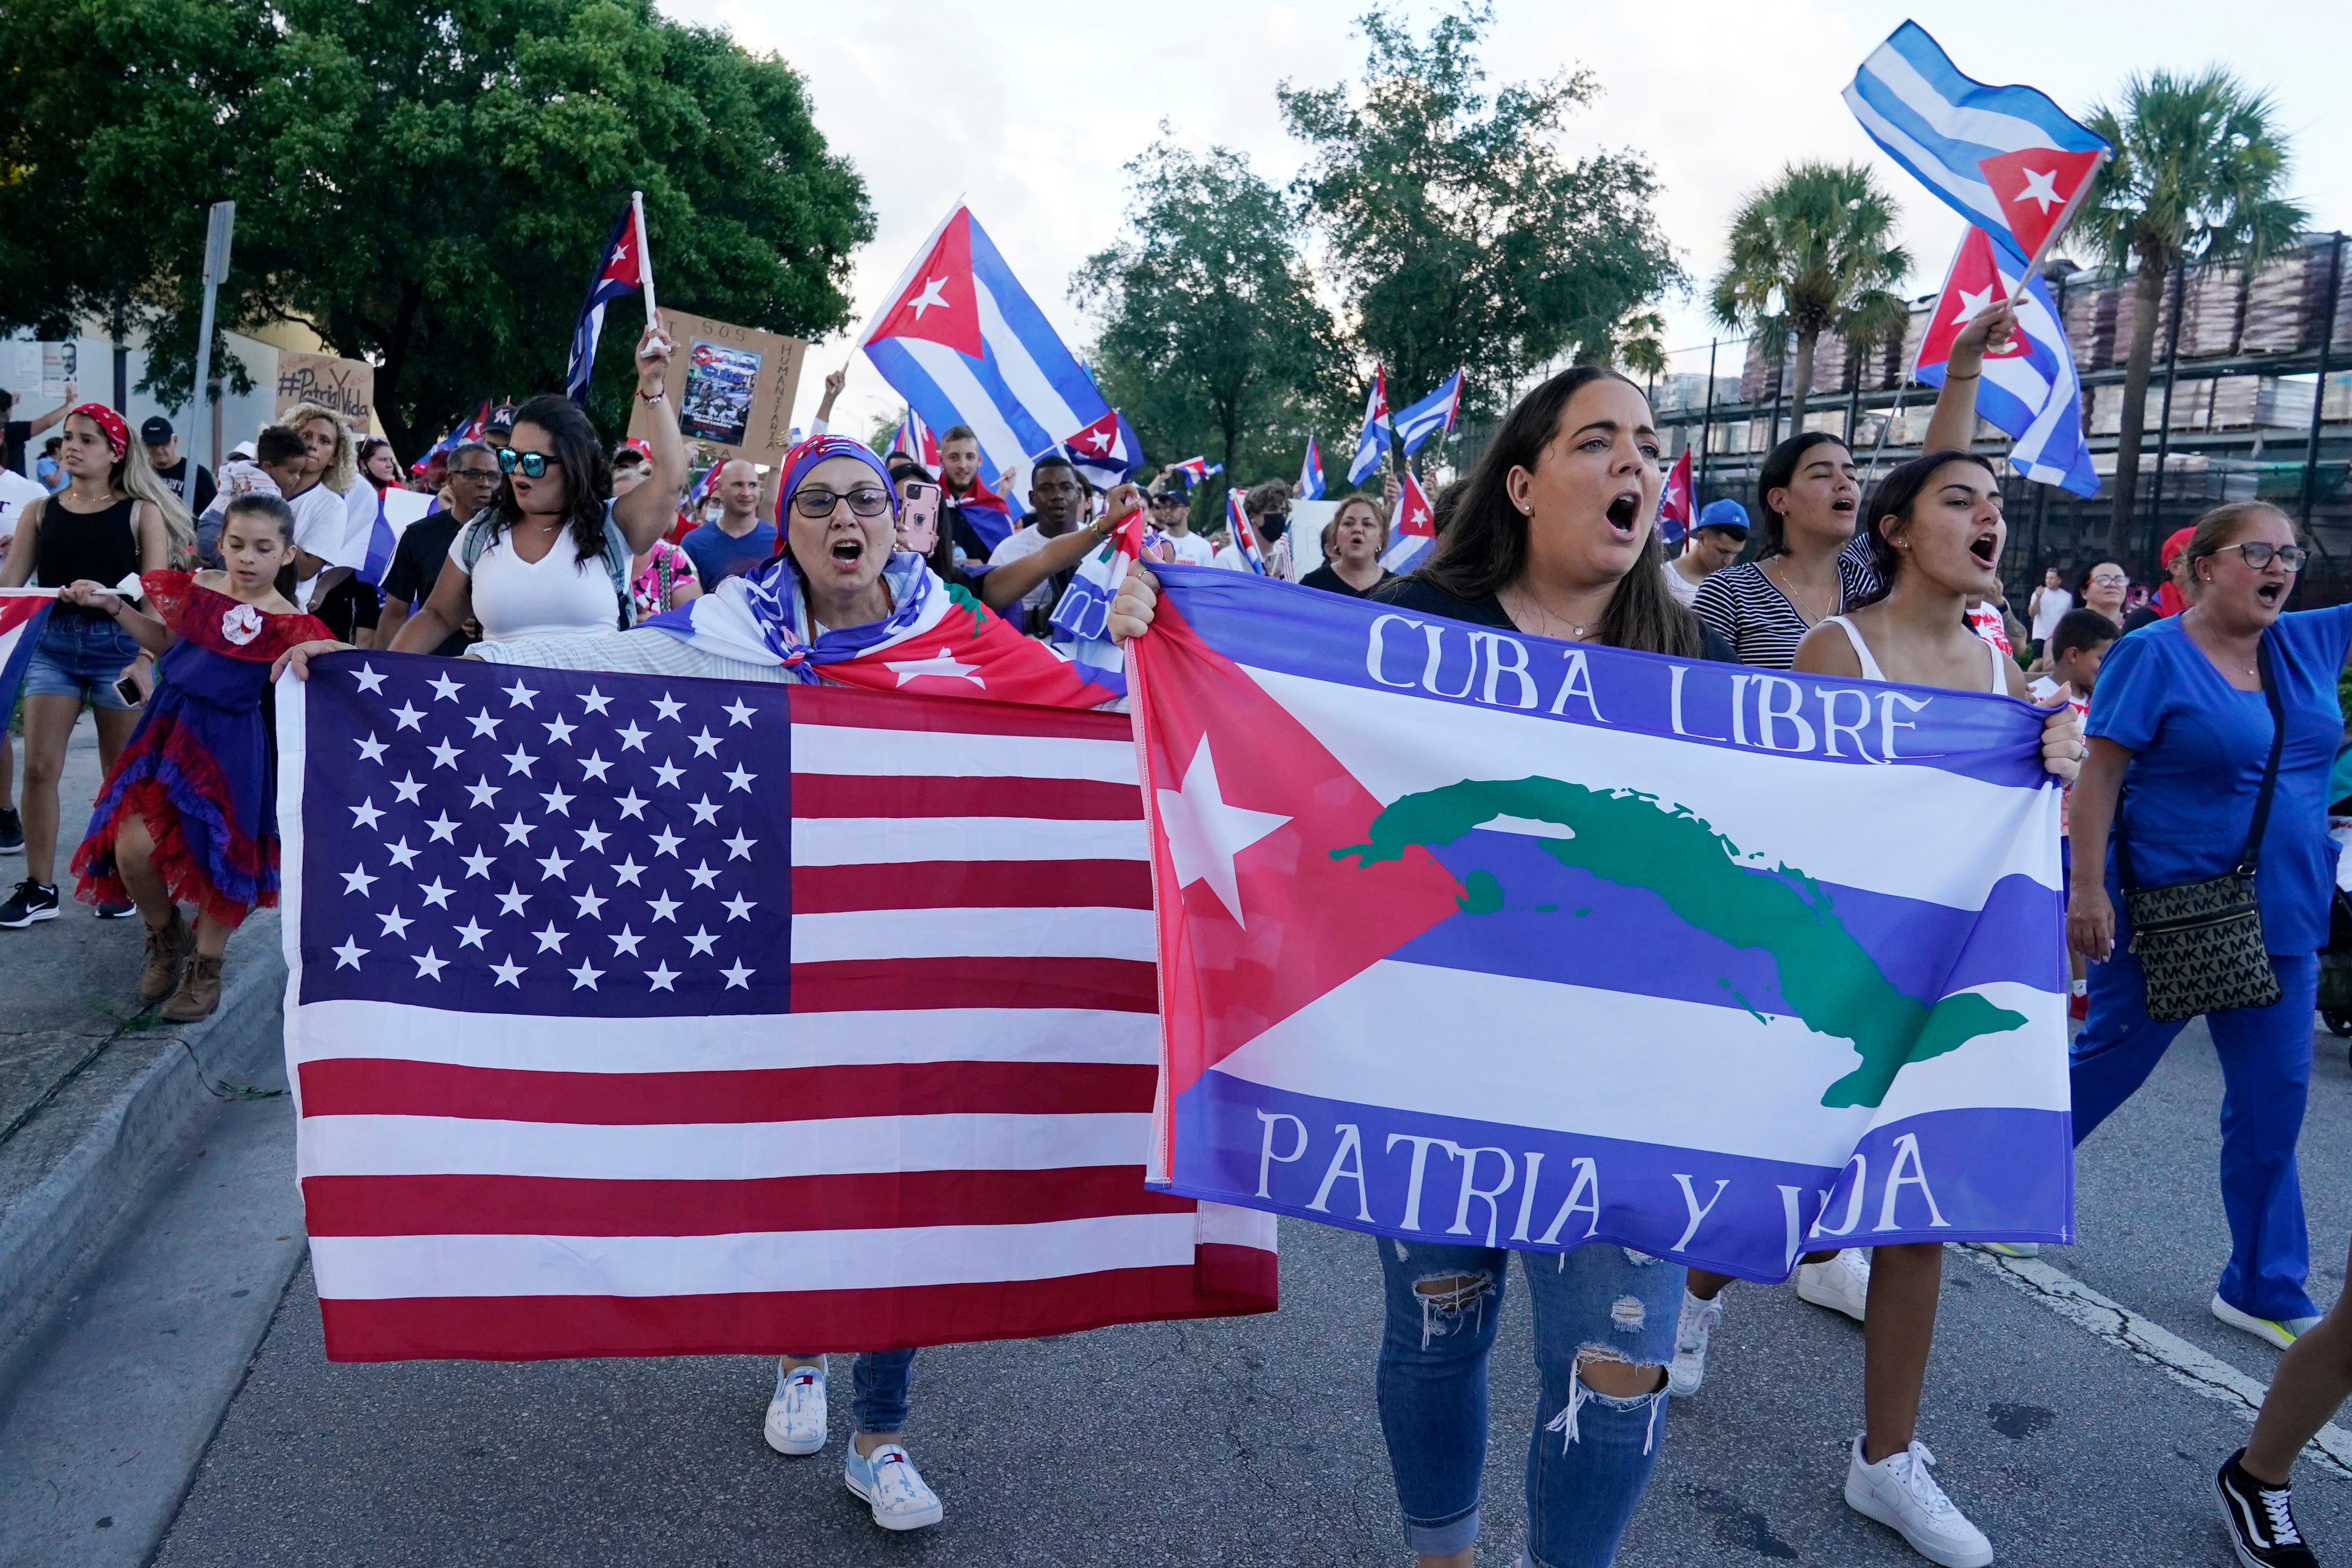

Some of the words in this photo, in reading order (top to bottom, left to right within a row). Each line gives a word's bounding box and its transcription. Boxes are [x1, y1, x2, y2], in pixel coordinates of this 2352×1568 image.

[702, 320, 746, 342] SOS
[766, 343, 792, 450] HUMANITARIA
[1367, 613, 1614, 723] CUBA
[1669, 664, 1947, 766] LIBRE
[2150, 890, 2176, 905] MK
[2177, 885, 2204, 900] MK
[2204, 878, 2232, 894] MK
[2139, 907, 2164, 922] MK
[2166, 902, 2192, 917] MK
[2193, 896, 2219, 911] MK
[2158, 934, 2183, 949] MK
[2185, 930, 2211, 945] MK
[2213, 924, 2239, 939] MK
[2148, 951, 2173, 965] MK
[2173, 948, 2199, 962] MK
[2202, 943, 2228, 958] MK
[2230, 938, 2254, 952] MK
[2162, 966, 2188, 978] MK
[2191, 961, 2217, 975] MK
[2219, 955, 2244, 971] MK
[2246, 948, 2266, 965] MK
[2150, 982, 2175, 995] MK
[2178, 978, 2204, 992] MK
[2206, 973, 2232, 989] MK
[2234, 967, 2260, 982] MK
[2167, 996, 2192, 1009] MK
[2195, 991, 2221, 1005] MK
[2223, 985, 2248, 1001] MK
[2251, 978, 2275, 994] MK
[1255, 1108, 1600, 1248] PATRIA
[1671, 1174, 1730, 1251] Y
